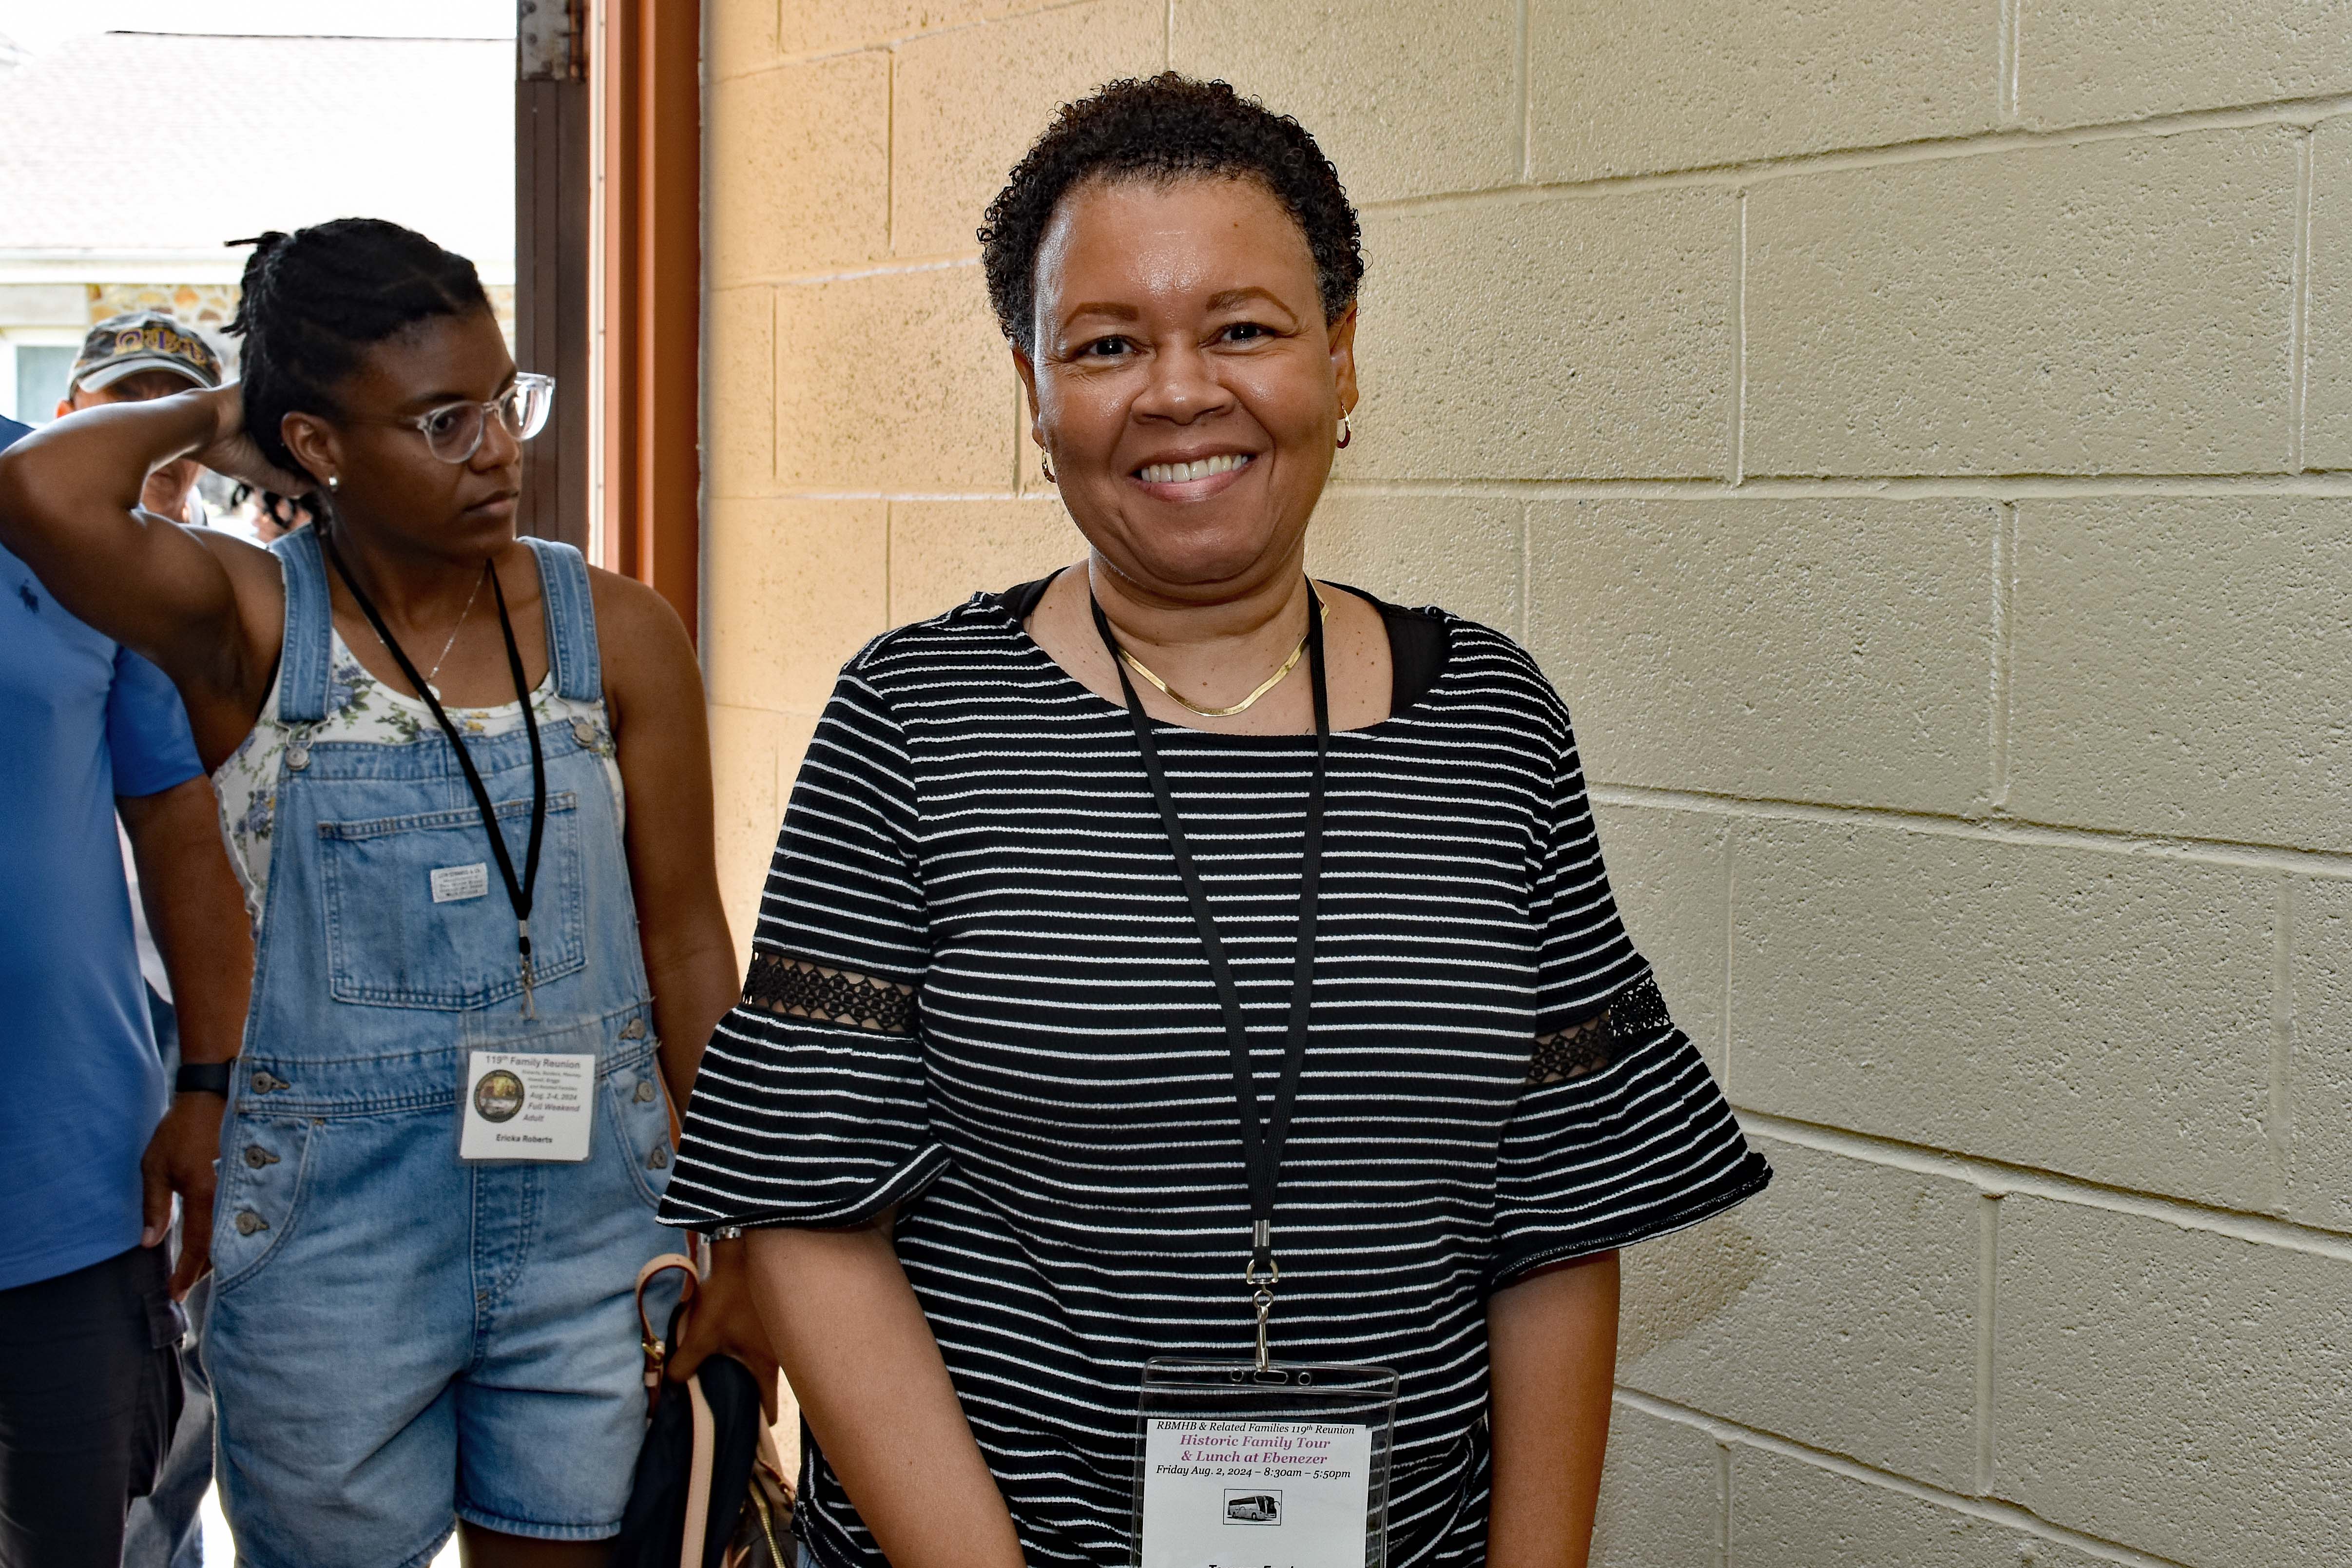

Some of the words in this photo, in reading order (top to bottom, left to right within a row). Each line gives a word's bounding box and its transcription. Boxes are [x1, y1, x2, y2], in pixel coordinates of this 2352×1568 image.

[510, 1057, 541, 1068] Family
[542, 1059, 581, 1069] Reunion
[527, 1102, 542, 1110] Full
[544, 1103, 581, 1112] Weekend
[496, 1134, 521, 1142] Ericka
[522, 1135, 553, 1143] Roberts
[1157, 1421, 1197, 1431] RBMHB
[1198, 1422, 1208, 1431] &
[1209, 1422, 1246, 1432] Related
[1248, 1423, 1289, 1432] Families
[1291, 1425, 1313, 1435] 119th
[1314, 1425, 1355, 1434] Reunion
[1179, 1434, 1239, 1447] Historic
[1241, 1436, 1293, 1451] Family
[1296, 1437, 1331, 1449] Tour
[1181, 1450, 1193, 1461] &
[1195, 1451, 1240, 1462] Lunch
[1244, 1453, 1259, 1463] at
[1262, 1452, 1328, 1464] Ebenezer
[1155, 1464, 1189, 1476] Friday
[1190, 1466, 1214, 1477] Aug.
[1215, 1468, 1225, 1477] 2,
[1227, 1468, 1253, 1478] 2024
[1264, 1467, 1302, 1478] 8:30am
[1313, 1470, 1351, 1480] 5:50pm
